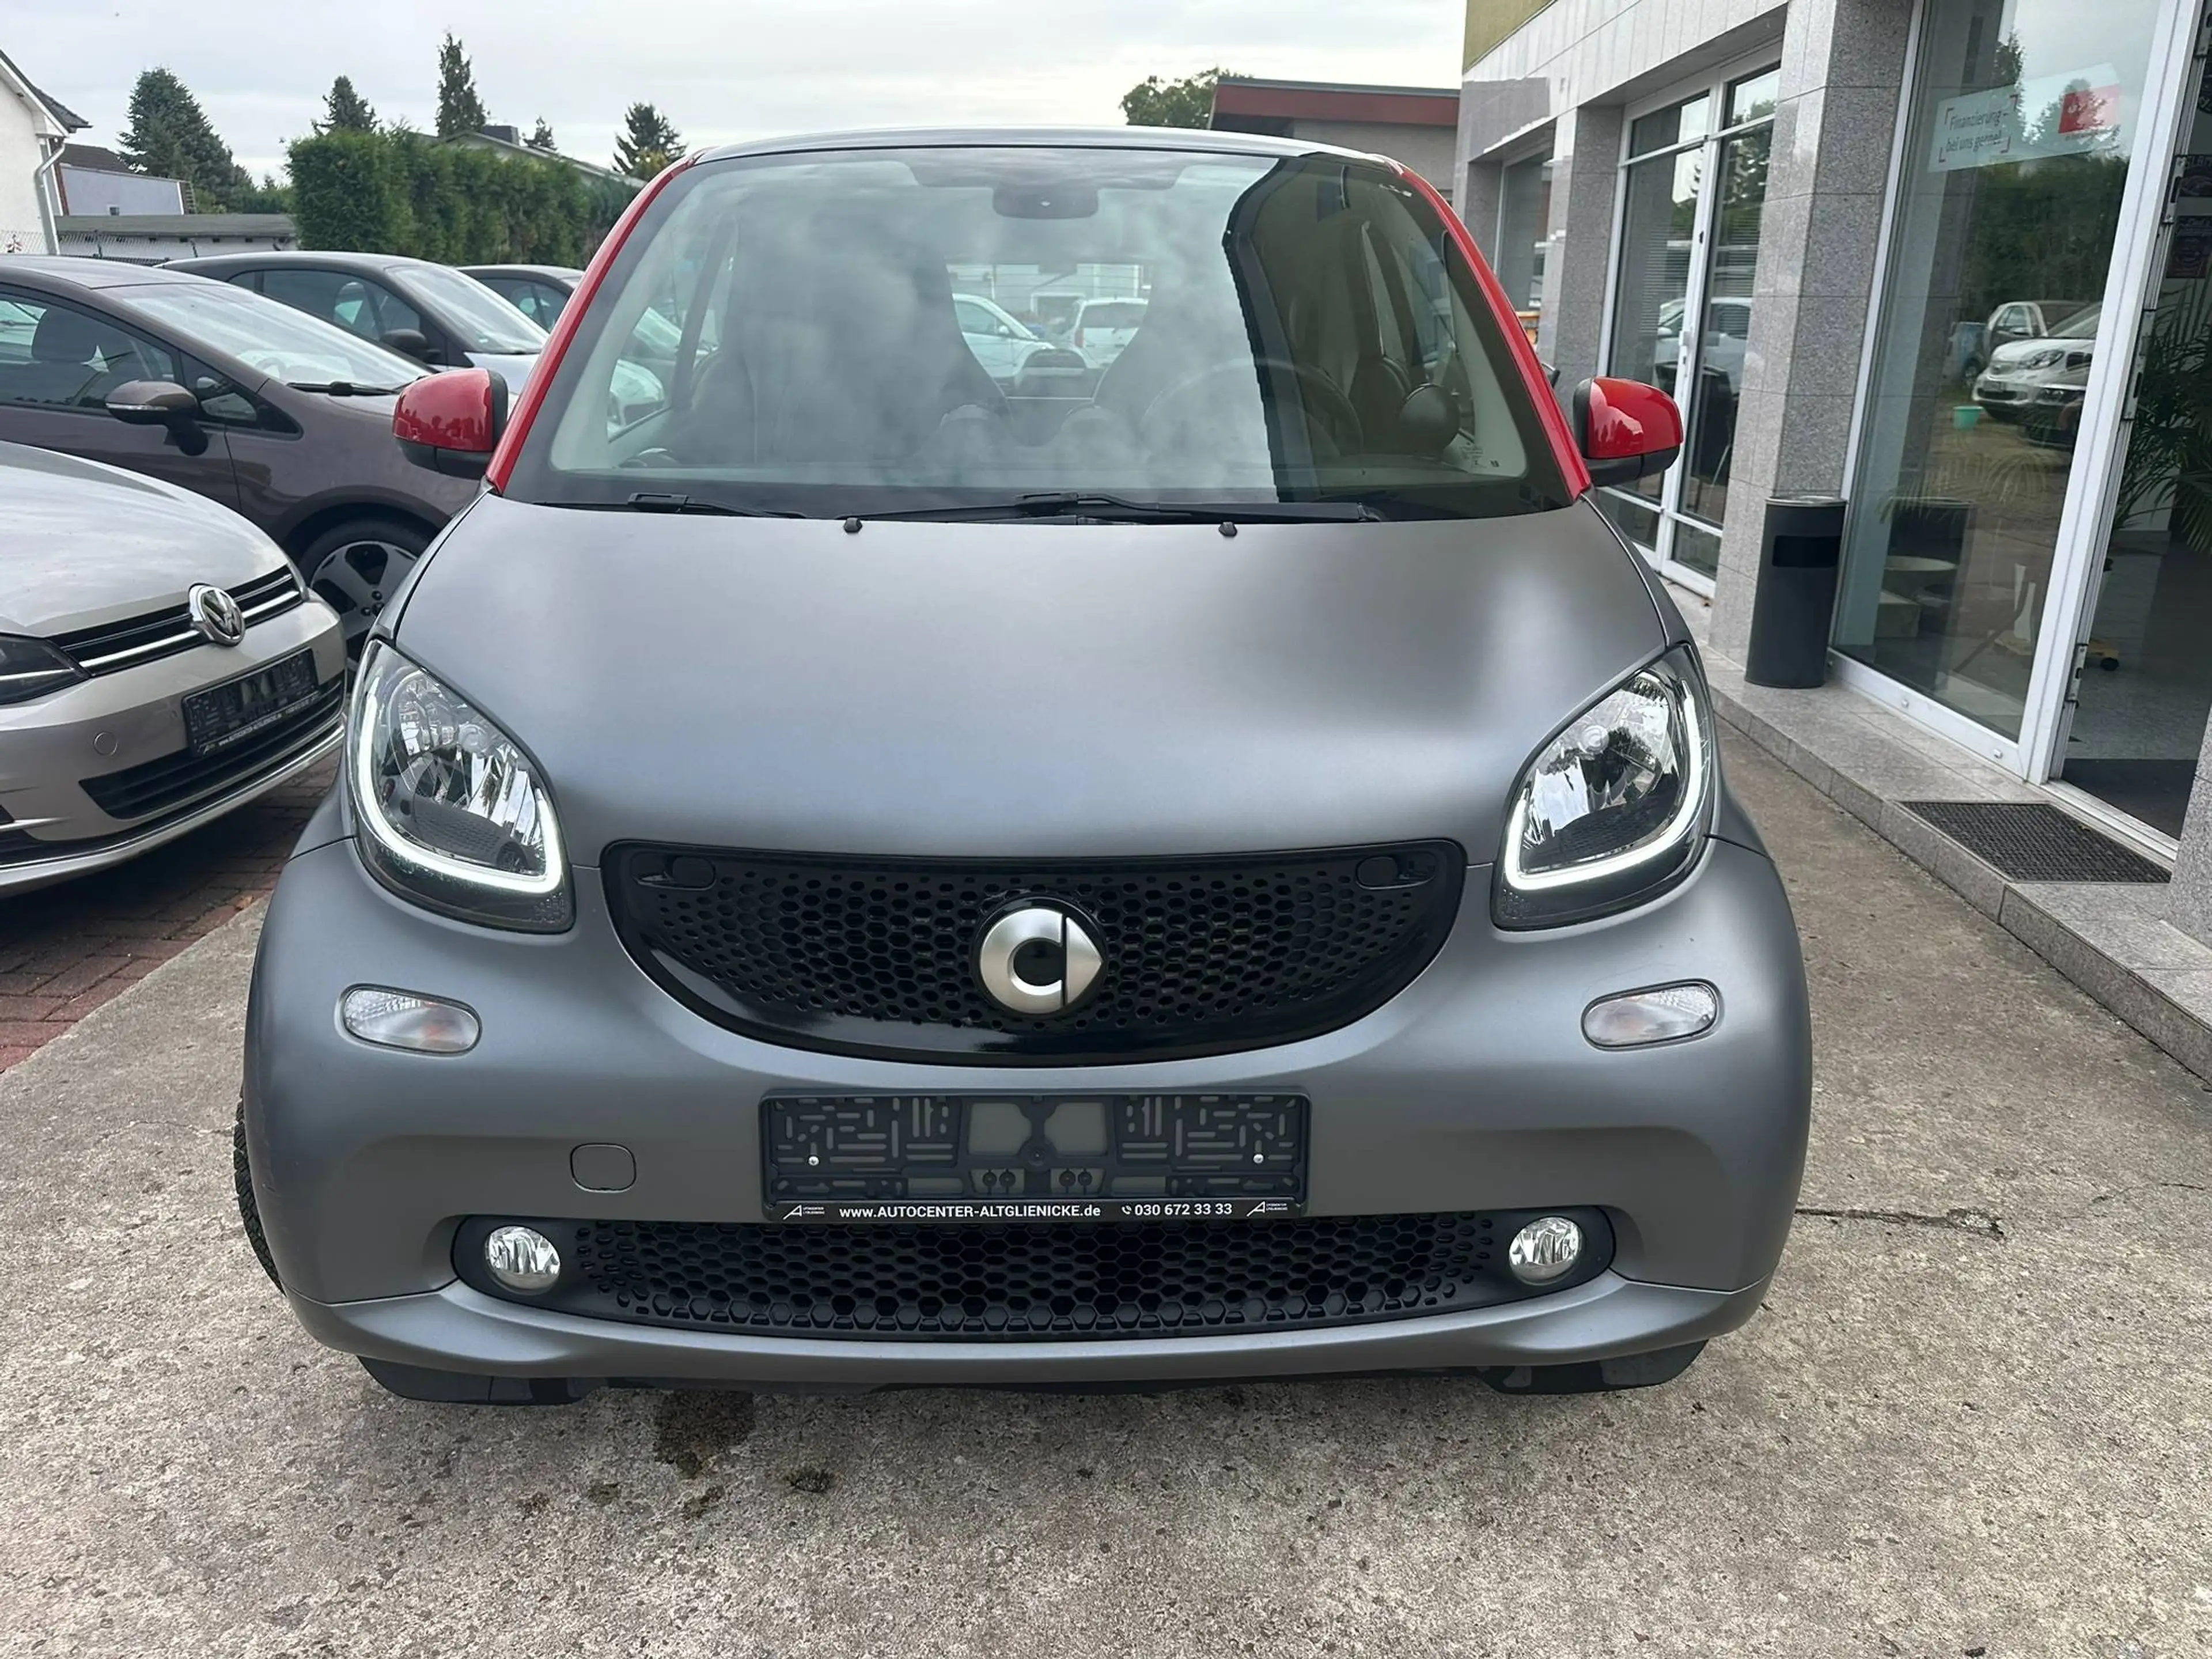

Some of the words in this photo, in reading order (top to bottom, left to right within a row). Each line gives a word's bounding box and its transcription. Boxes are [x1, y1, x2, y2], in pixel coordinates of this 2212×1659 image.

[839, 1205, 1101, 1218] www.AUTOCENTER-ALTGLIENICKE.de
[1134, 1205, 1161, 1216] 030
[1164, 1205, 1190, 1215] 672
[1194, 1204, 1211, 1215] 33
[1214, 1204, 1232, 1215] 33
